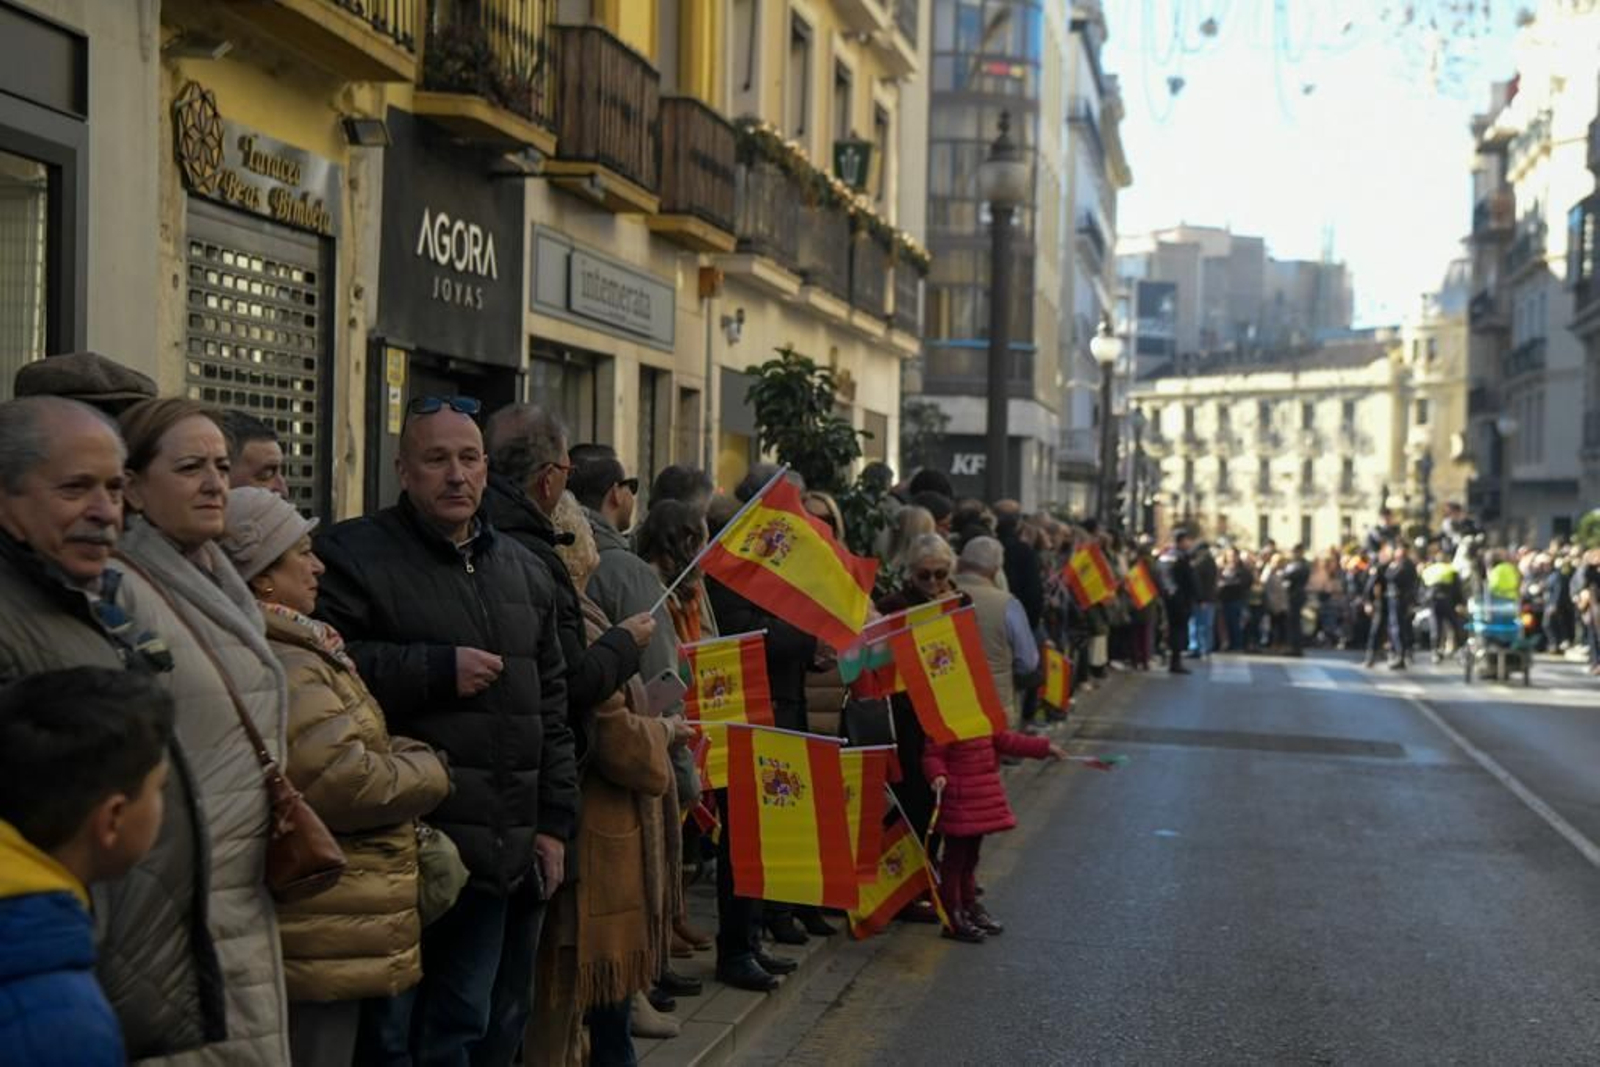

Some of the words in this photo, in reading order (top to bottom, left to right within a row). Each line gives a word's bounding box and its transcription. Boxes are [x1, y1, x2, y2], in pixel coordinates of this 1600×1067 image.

[416, 206, 498, 280] AGORA
[432, 276, 483, 310] JOYAS
[950, 453, 987, 475] KF
